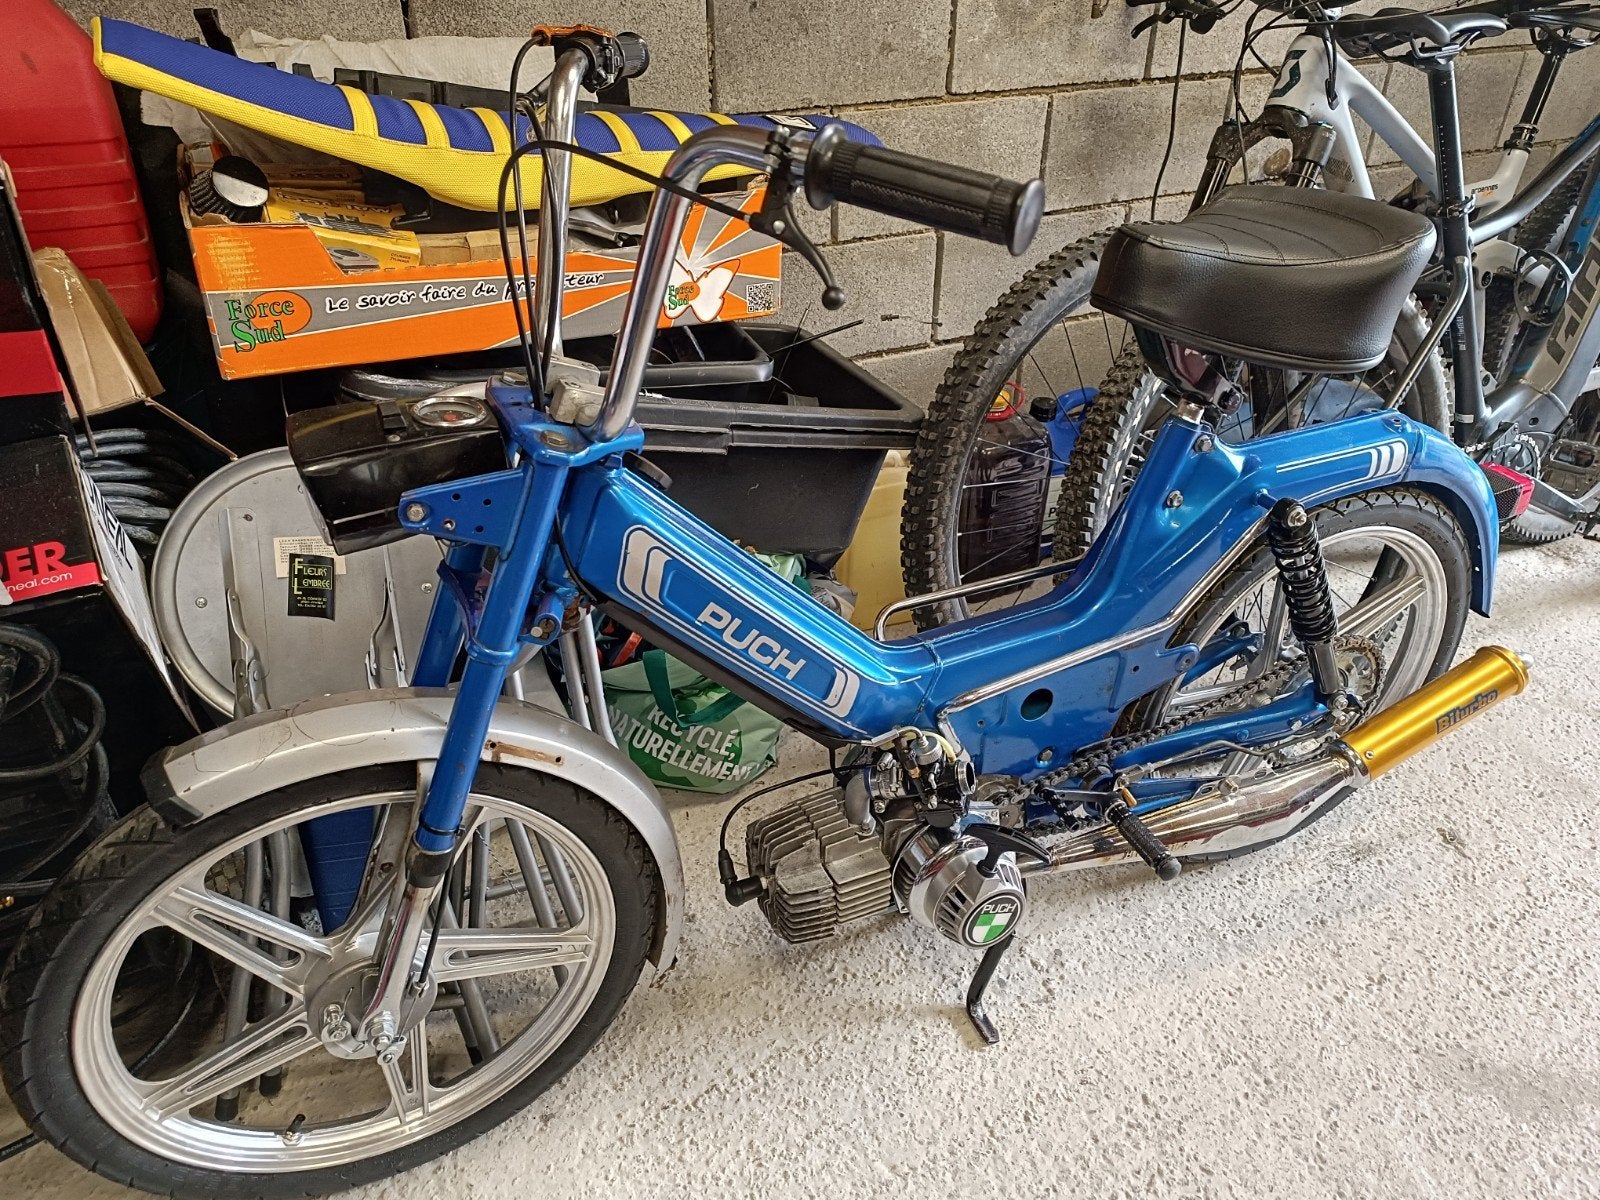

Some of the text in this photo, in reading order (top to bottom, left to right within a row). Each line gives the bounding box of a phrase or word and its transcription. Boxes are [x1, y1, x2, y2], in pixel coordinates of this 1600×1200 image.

[327, 299, 348, 312] Le
[358, 290, 416, 308] savoir
[421, 285, 466, 301] faire
[474, 281, 497, 294] du
[668, 285, 695, 296] Force
[668, 295, 690, 310] Sud
[224, 299, 295, 321] Force
[231, 319, 287, 353] Sud
[0, 541, 69, 583] ER
[697, 602, 807, 681] PUCH
[1436, 688, 1499, 734] Biturbo
[981, 903, 1018, 914] PUCH
